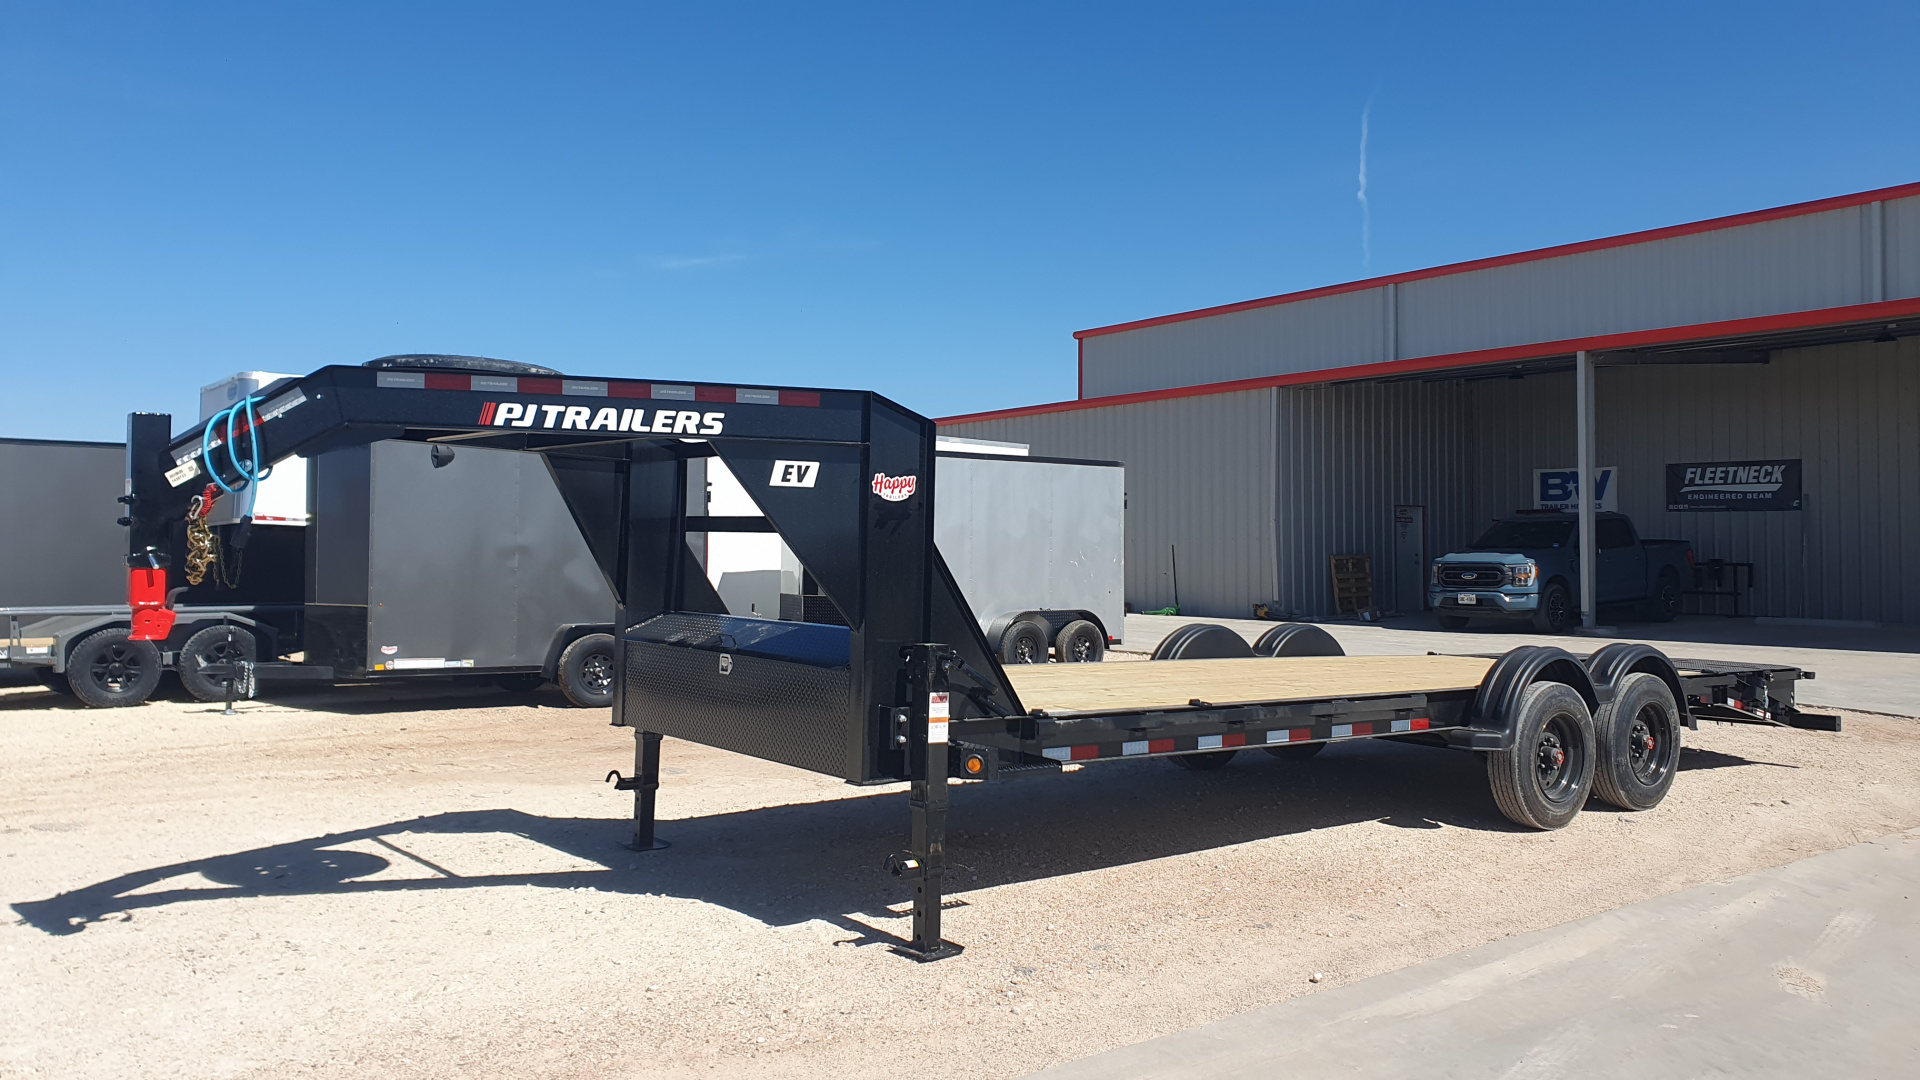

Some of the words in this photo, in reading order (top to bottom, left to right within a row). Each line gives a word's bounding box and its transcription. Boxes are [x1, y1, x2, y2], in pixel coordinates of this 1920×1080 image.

[494, 403, 538, 427] PJ
[541, 405, 725, 435] TRAILERS
[781, 465, 810, 483] EV
[1684, 465, 1786, 484] FLEETNECK
[873, 474, 915, 495] Happy
